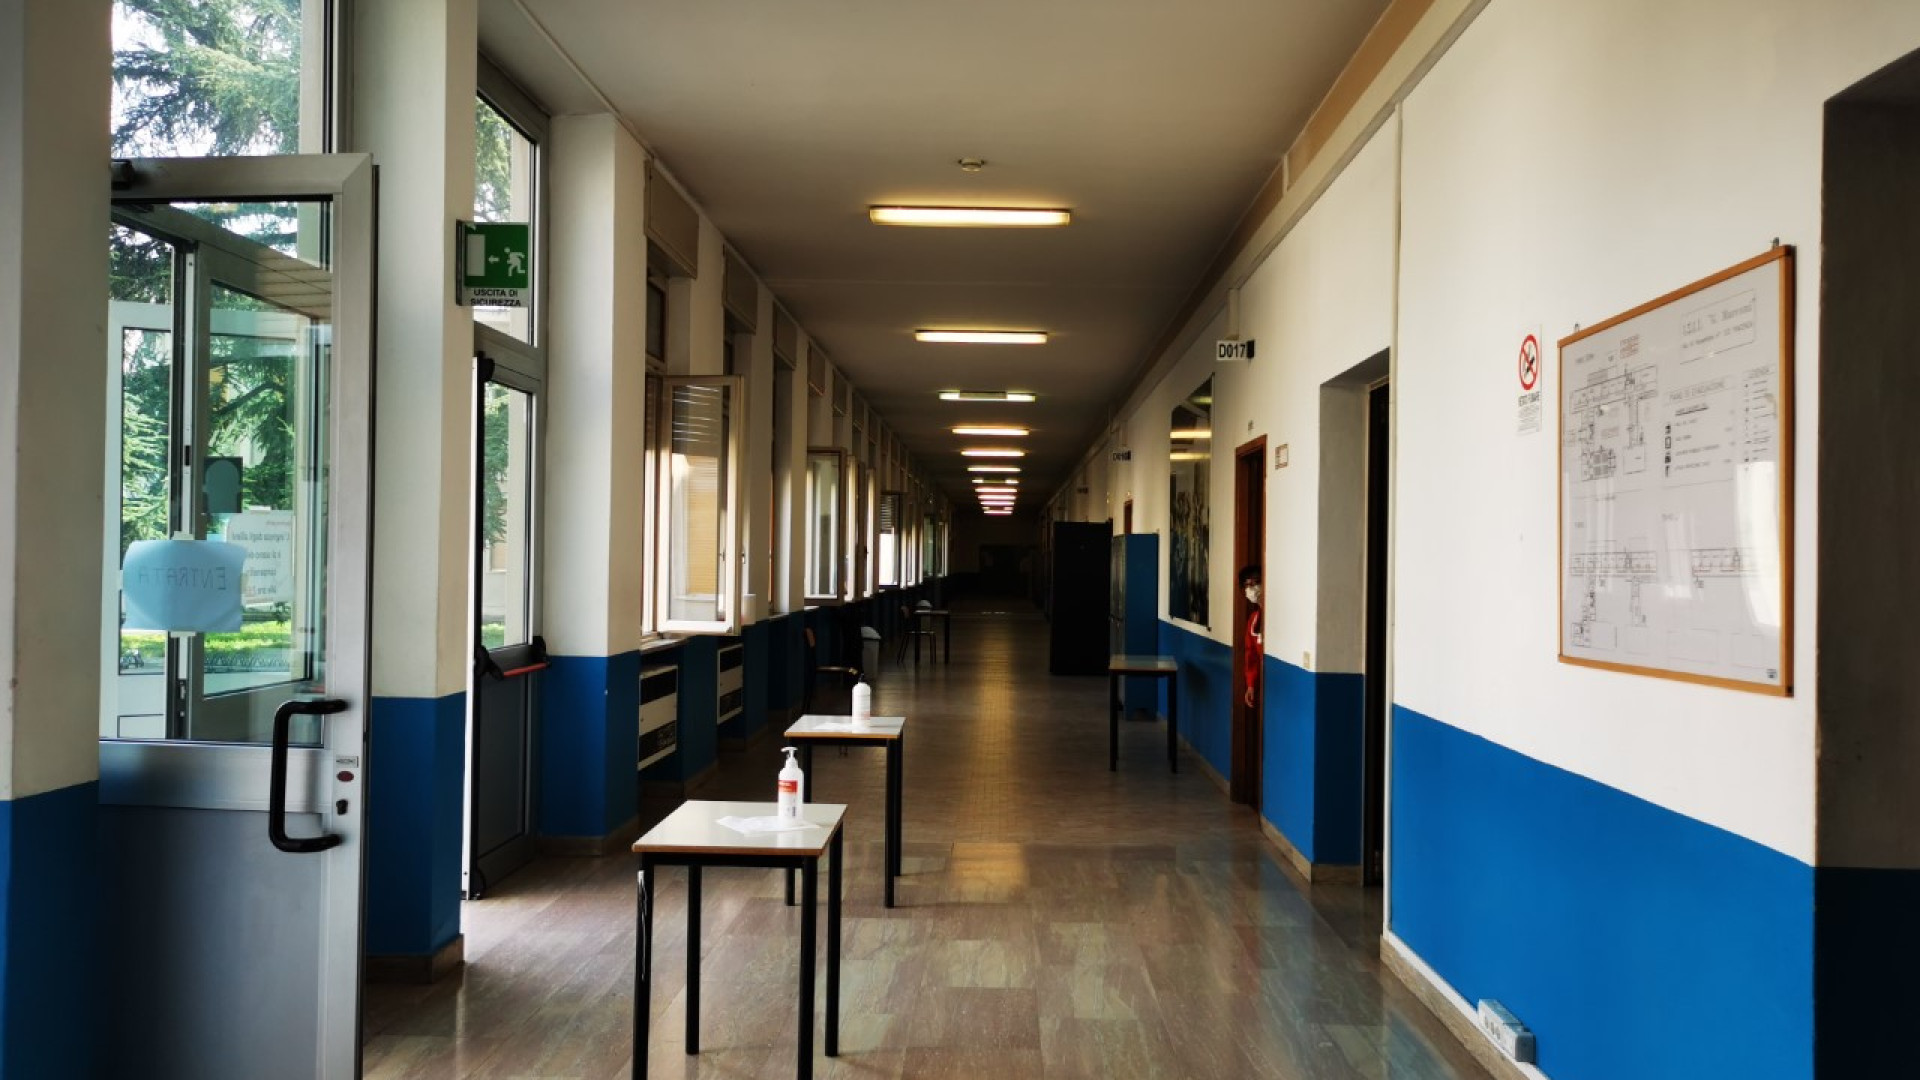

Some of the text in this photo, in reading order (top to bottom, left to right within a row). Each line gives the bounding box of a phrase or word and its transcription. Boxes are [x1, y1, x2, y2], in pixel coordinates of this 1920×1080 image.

[473, 288, 518, 297] USCITA DI
[470, 298, 521, 306] SICUREZZA
[1218, 343, 1246, 358] D017
